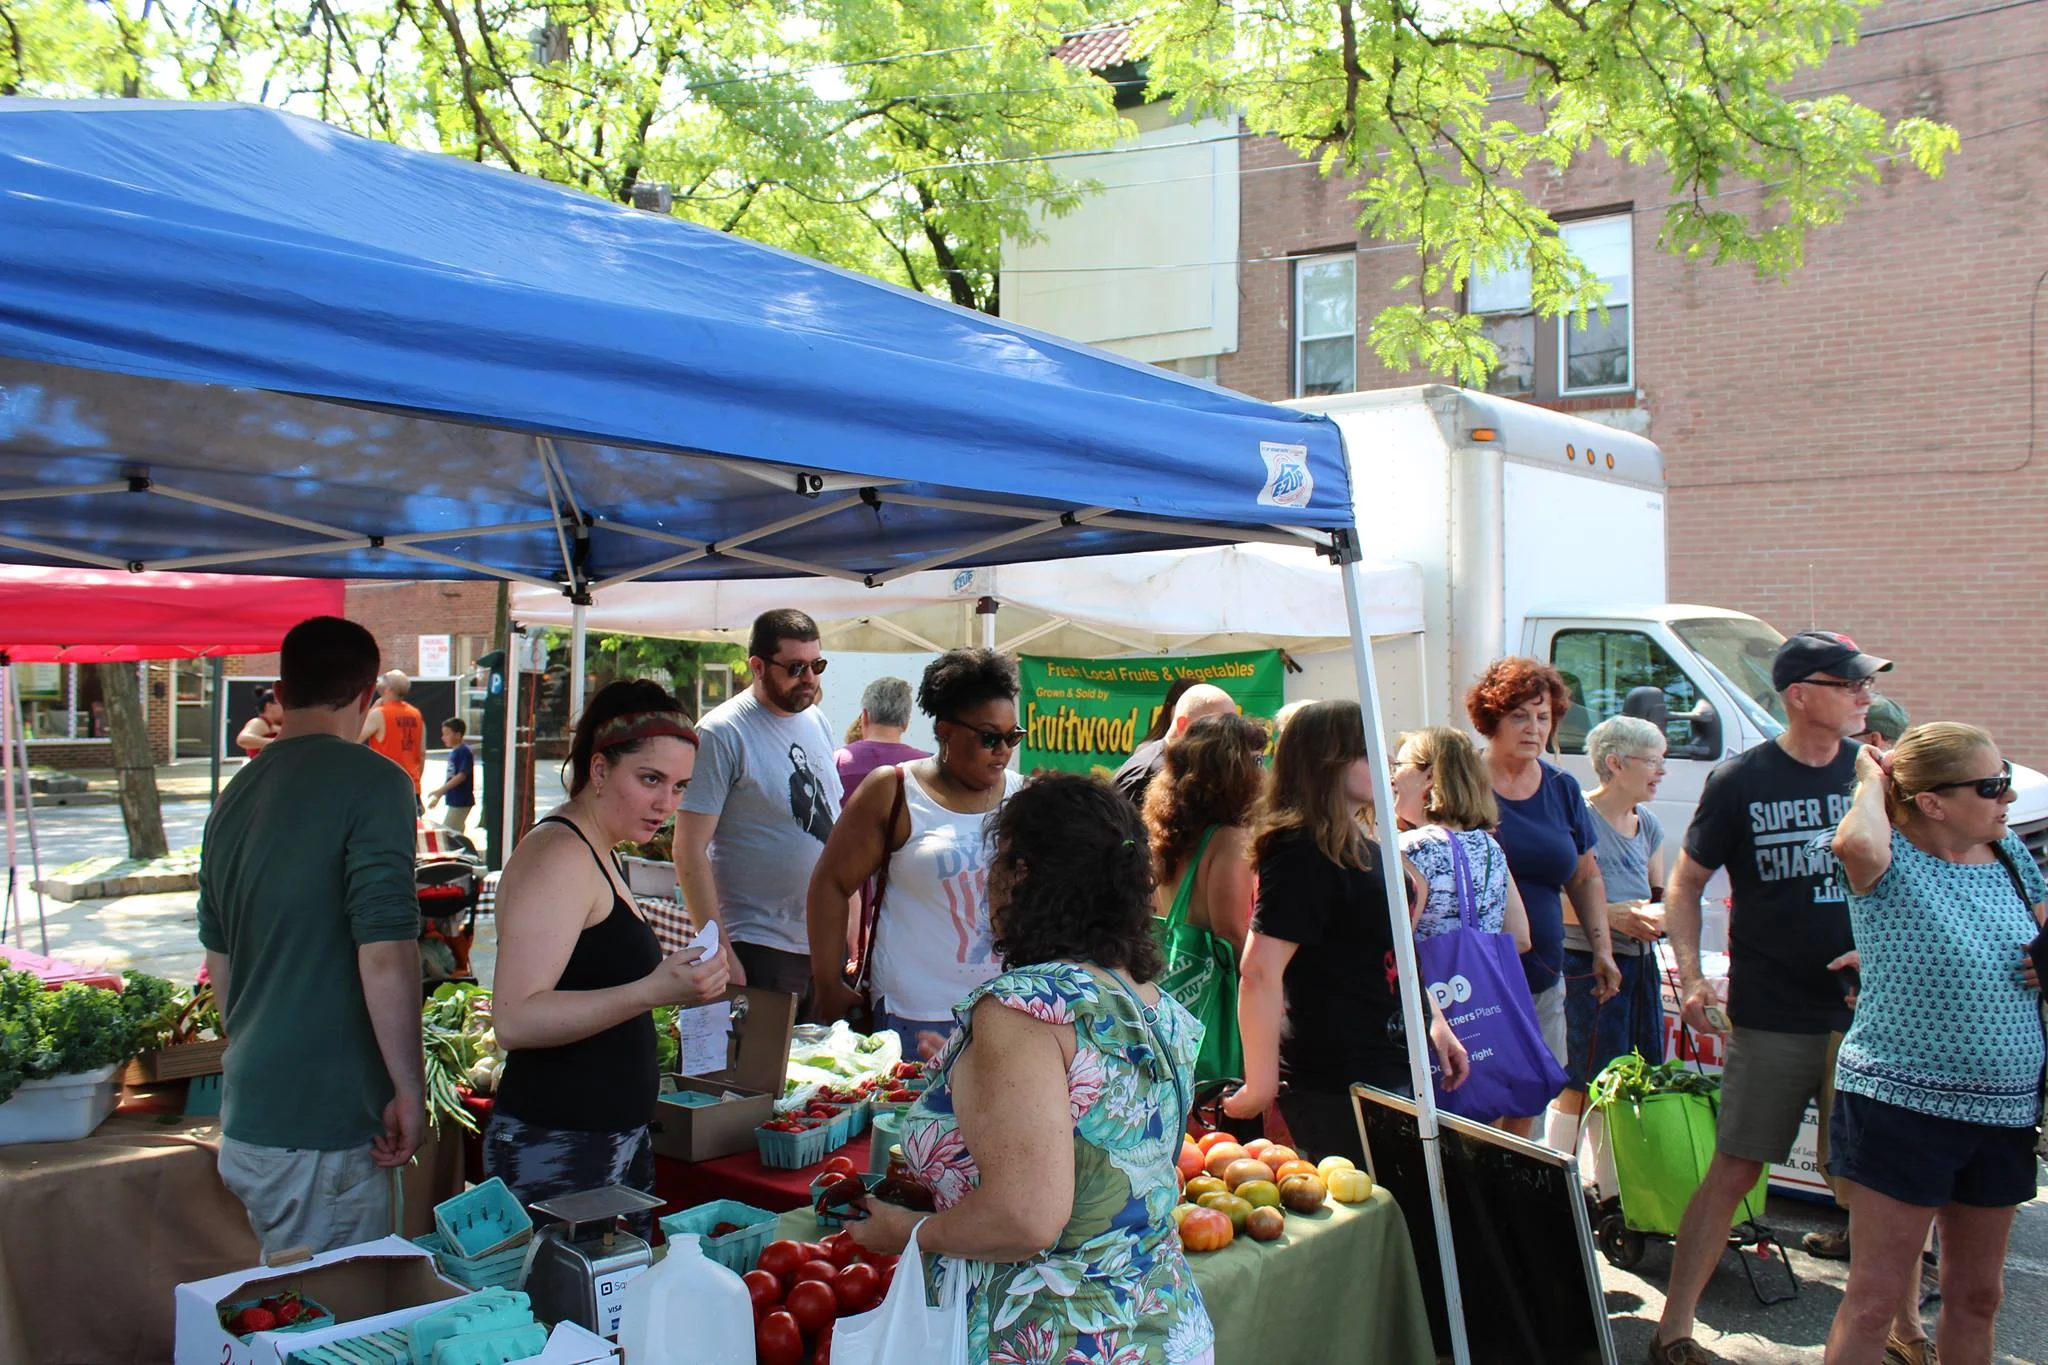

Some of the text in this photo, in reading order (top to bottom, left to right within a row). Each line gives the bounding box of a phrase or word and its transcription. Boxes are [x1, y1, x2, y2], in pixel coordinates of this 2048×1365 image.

[1046, 661, 1255, 682] Fresh Local Fruits & Vegetables
[1036, 687, 1110, 702] Grown & Sold by
[1026, 701, 1139, 754] Fruitwood
[1749, 798, 1823, 834] SUPER
[1475, 1004, 1502, 1019] Plans
[1471, 1047, 1494, 1062] right
[607, 1304, 623, 1314] VISA
